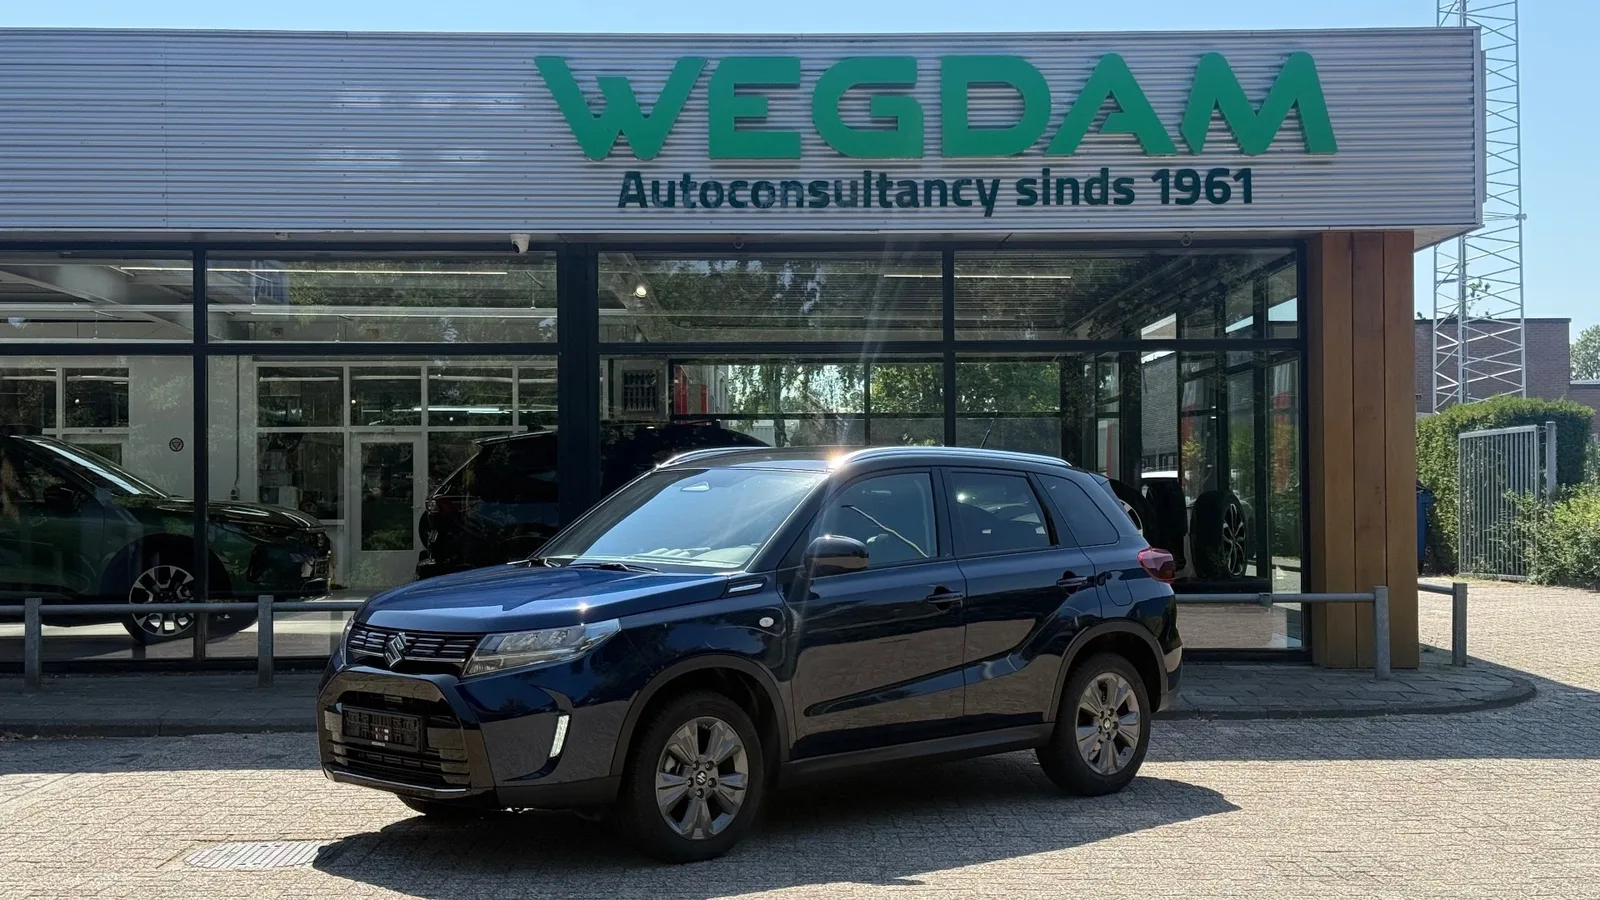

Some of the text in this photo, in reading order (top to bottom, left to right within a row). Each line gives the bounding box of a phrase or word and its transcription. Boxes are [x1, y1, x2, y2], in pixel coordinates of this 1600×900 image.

[533, 51, 1338, 161] WEGDAM
[617, 167, 1253, 217] Autoconsultancy sinds 1961
